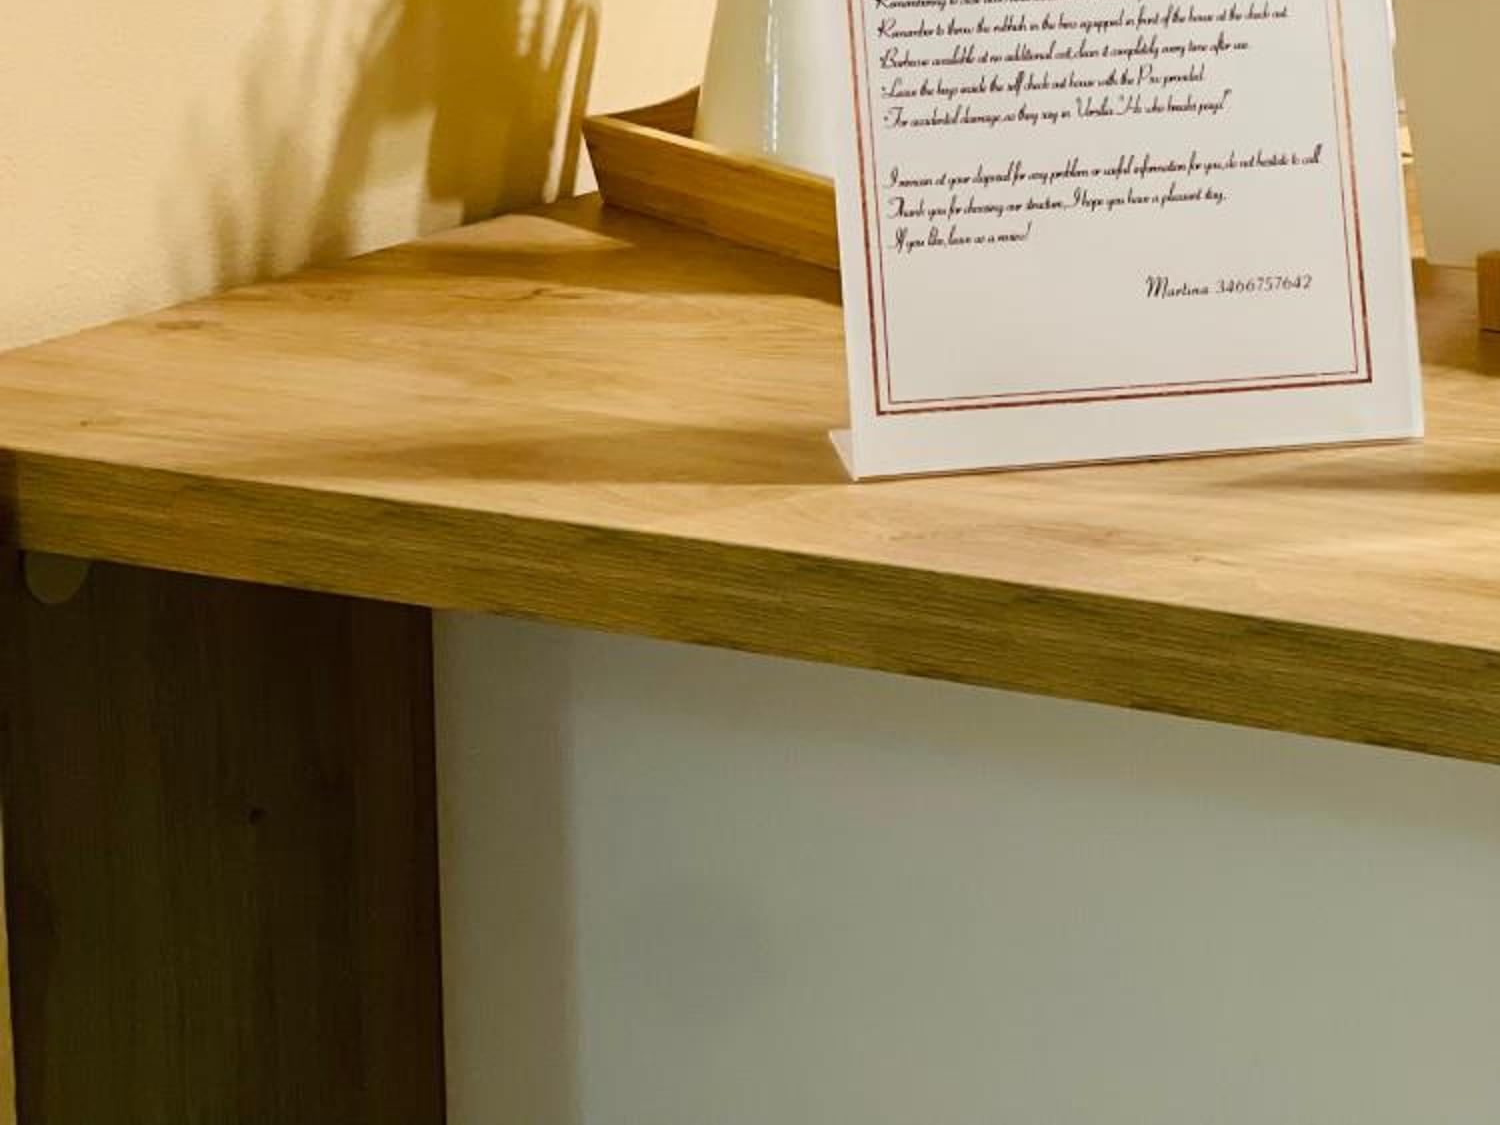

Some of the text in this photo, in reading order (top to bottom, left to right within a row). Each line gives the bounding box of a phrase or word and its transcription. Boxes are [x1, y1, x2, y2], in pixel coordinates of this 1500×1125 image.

[934, 22, 945, 37] to
[975, 15, 991, 34] the
[1041, 11, 1055, 31] the
[1227, 1, 1242, 22] the
[919, 77, 934, 97] the
[989, 73, 1004, 94] the
[1119, 67, 1134, 86] the
[1145, 273, 1313, 300] Martina 3466757642
